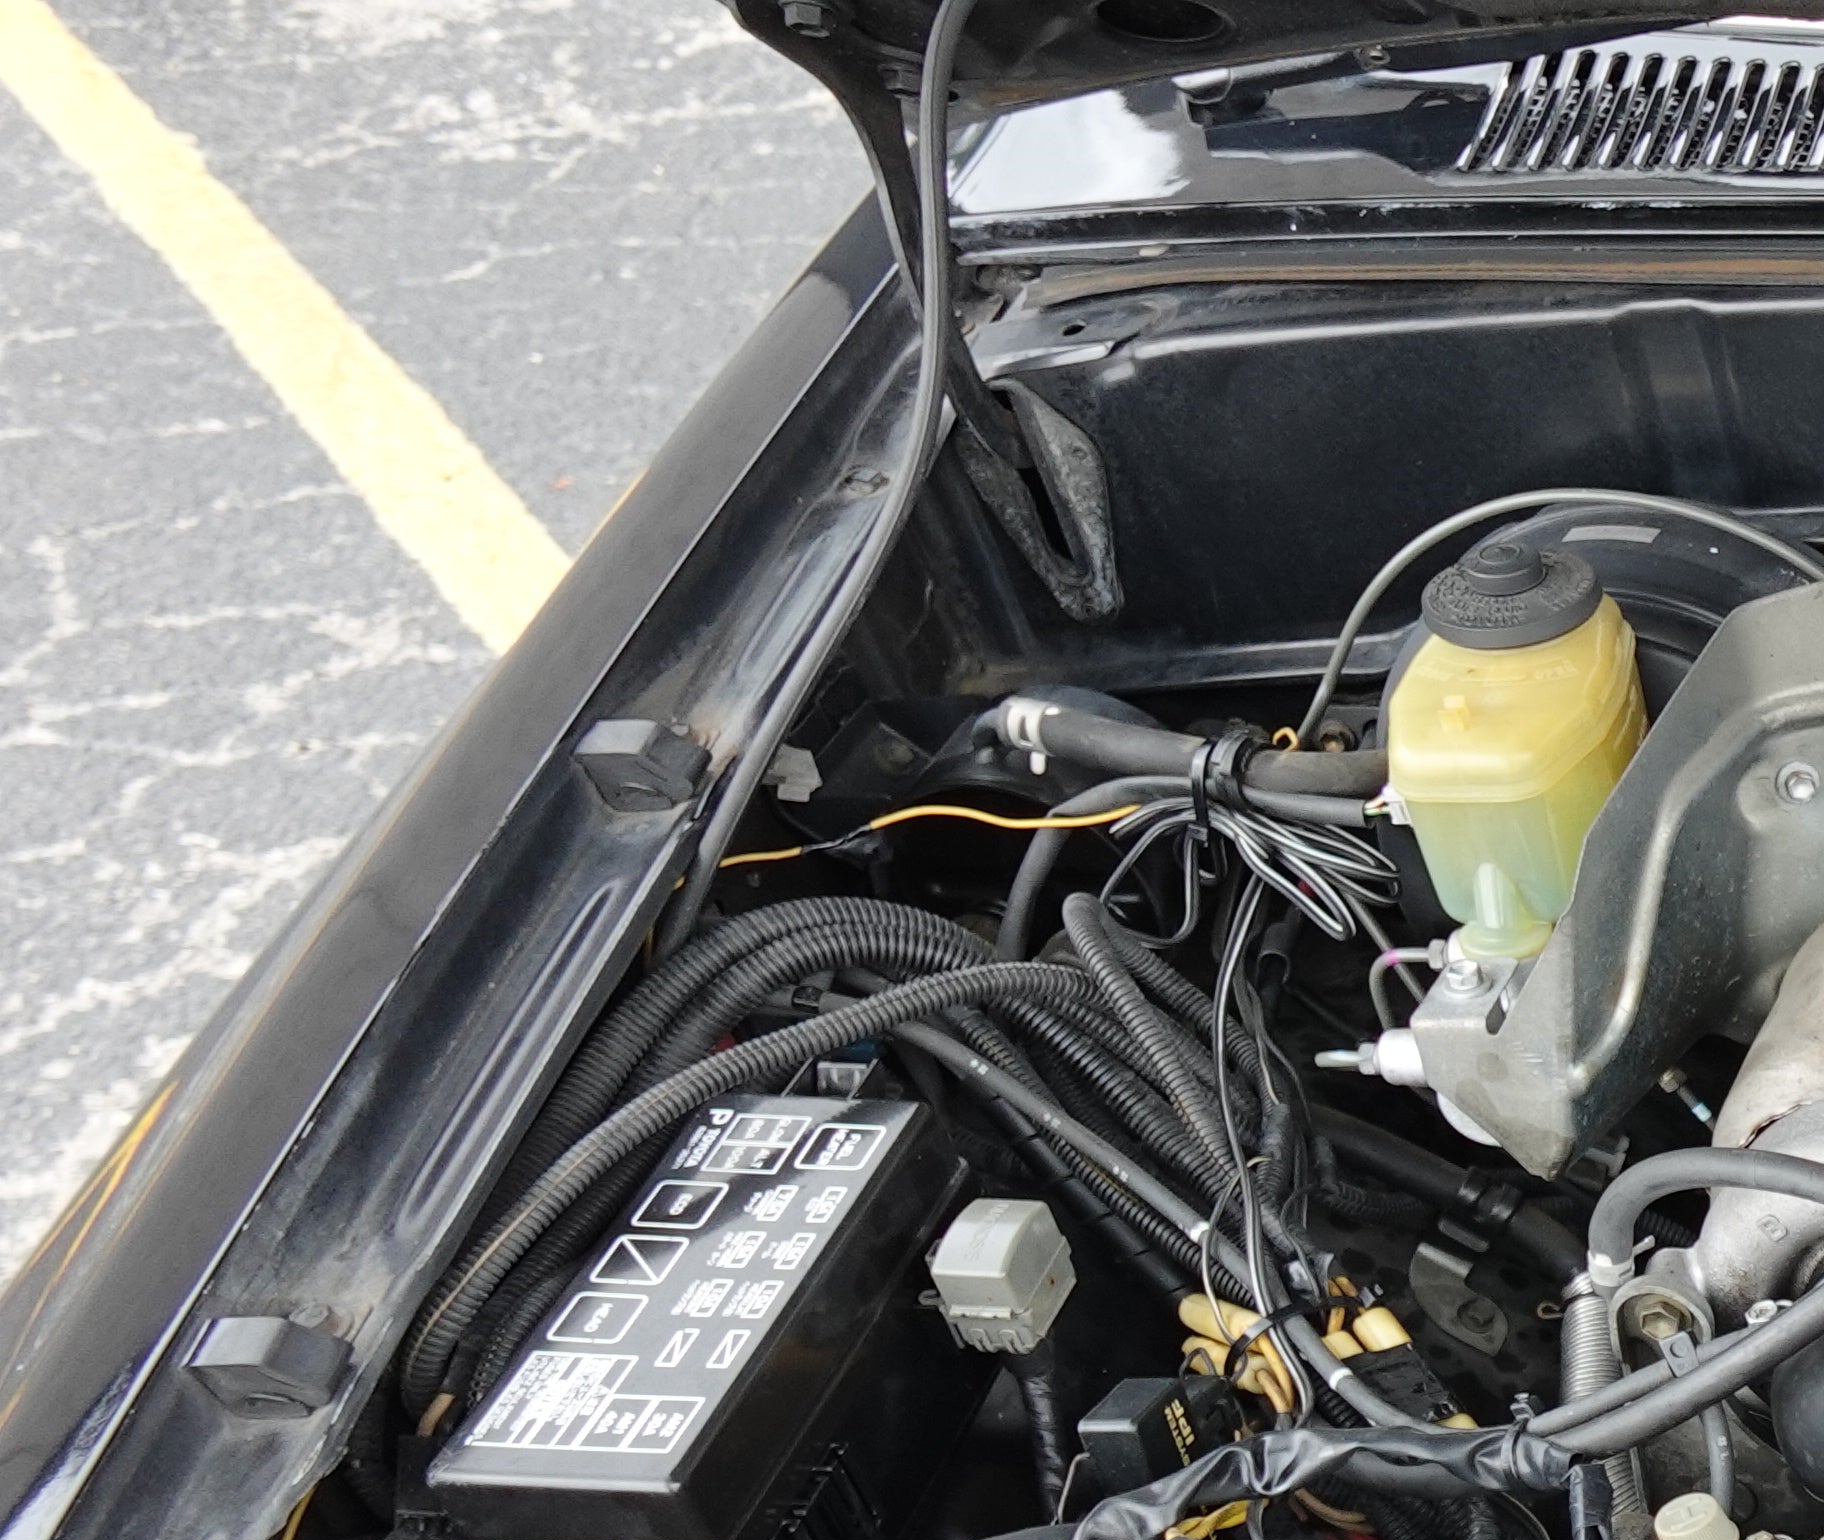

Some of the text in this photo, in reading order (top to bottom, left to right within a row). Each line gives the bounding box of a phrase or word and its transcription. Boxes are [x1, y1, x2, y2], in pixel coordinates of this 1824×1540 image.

[686, 1128, 724, 1169] TOYOTA
[835, 1134, 862, 1160] FUEL
[583, 1302, 614, 1332] HEAD
[1171, 1398, 1196, 1447] IPF
